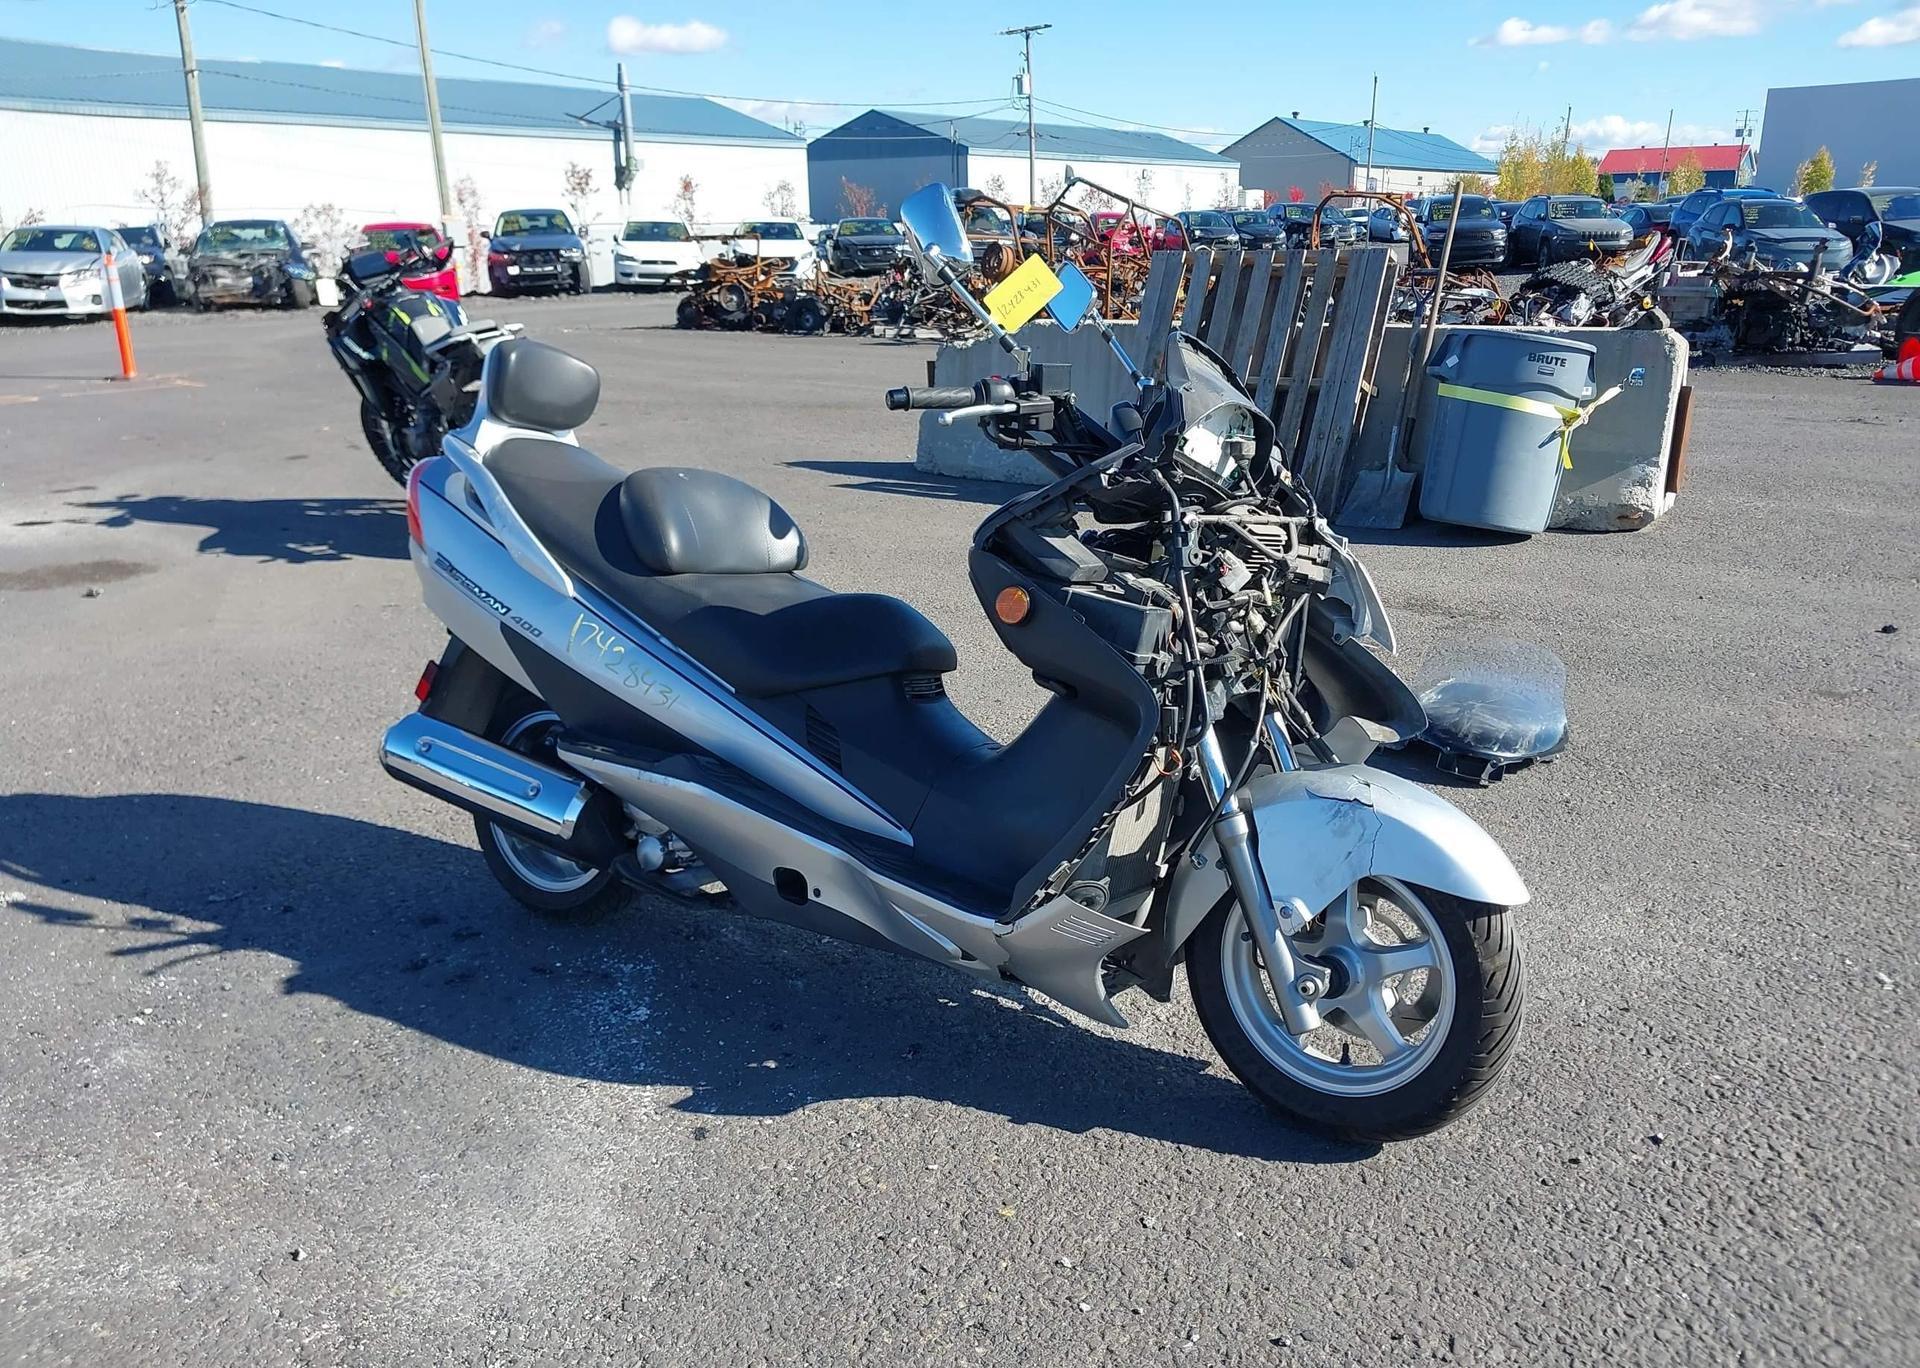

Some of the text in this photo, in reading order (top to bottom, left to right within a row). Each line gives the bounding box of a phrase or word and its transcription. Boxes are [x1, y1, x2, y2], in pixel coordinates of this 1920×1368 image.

[1528, 352, 1567, 367] BRUTE
[510, 615, 543, 638] 400
[567, 612, 680, 710] 17428431
